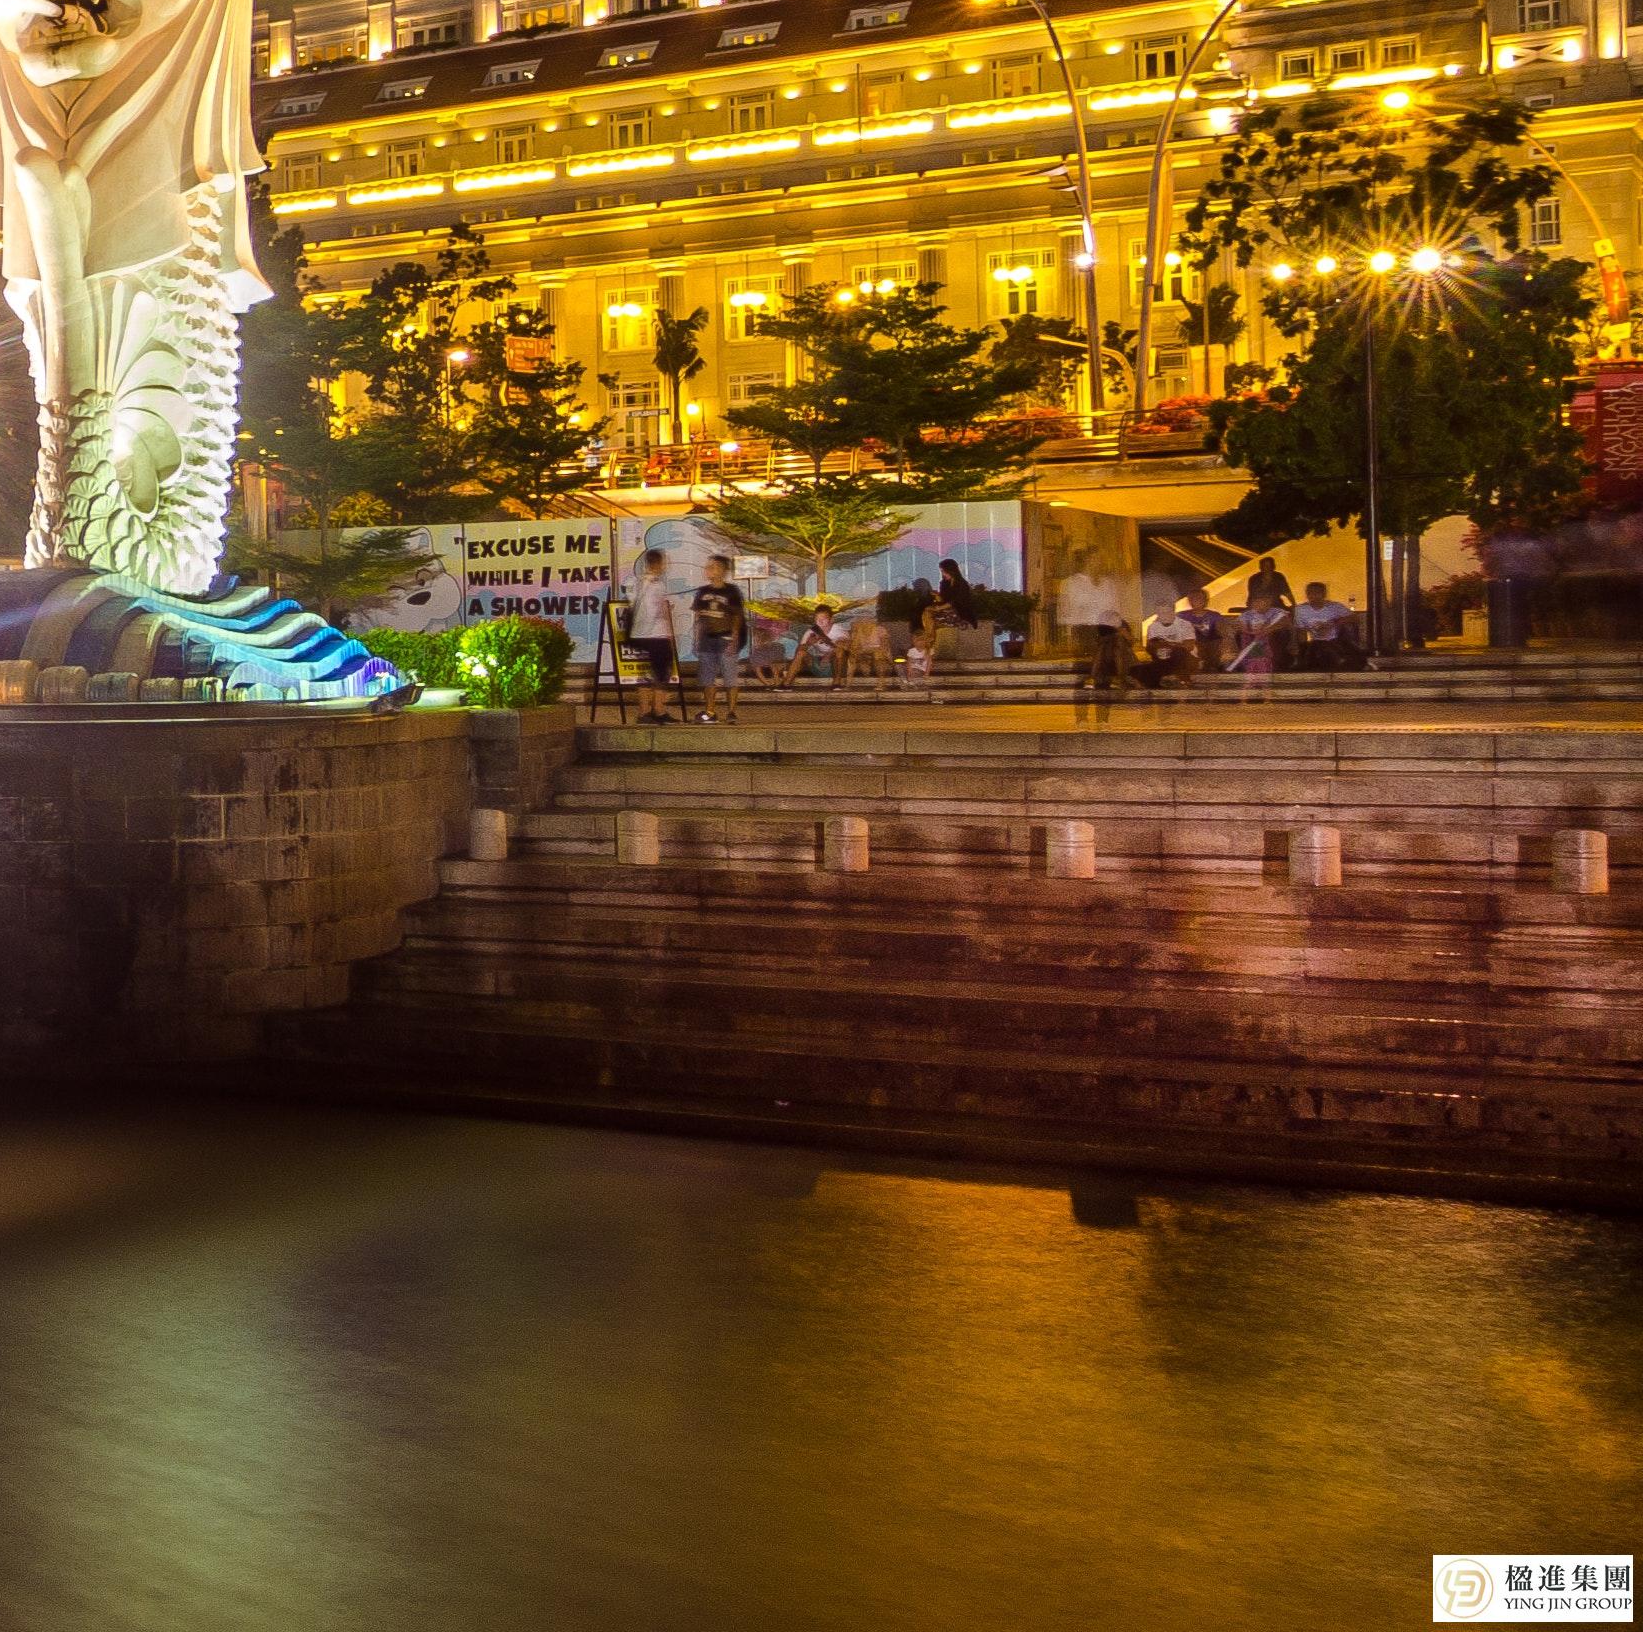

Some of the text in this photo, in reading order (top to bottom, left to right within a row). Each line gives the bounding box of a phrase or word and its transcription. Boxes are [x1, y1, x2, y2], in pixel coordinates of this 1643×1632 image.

[1602, 388, 1623, 471] MAJULAH
[1619, 381, 1637, 480] SINGAPURA
[565, 535, 602, 554] ME
[468, 566, 610, 587] WHILE I TAKE
[468, 596, 600, 616] A SHOWER
